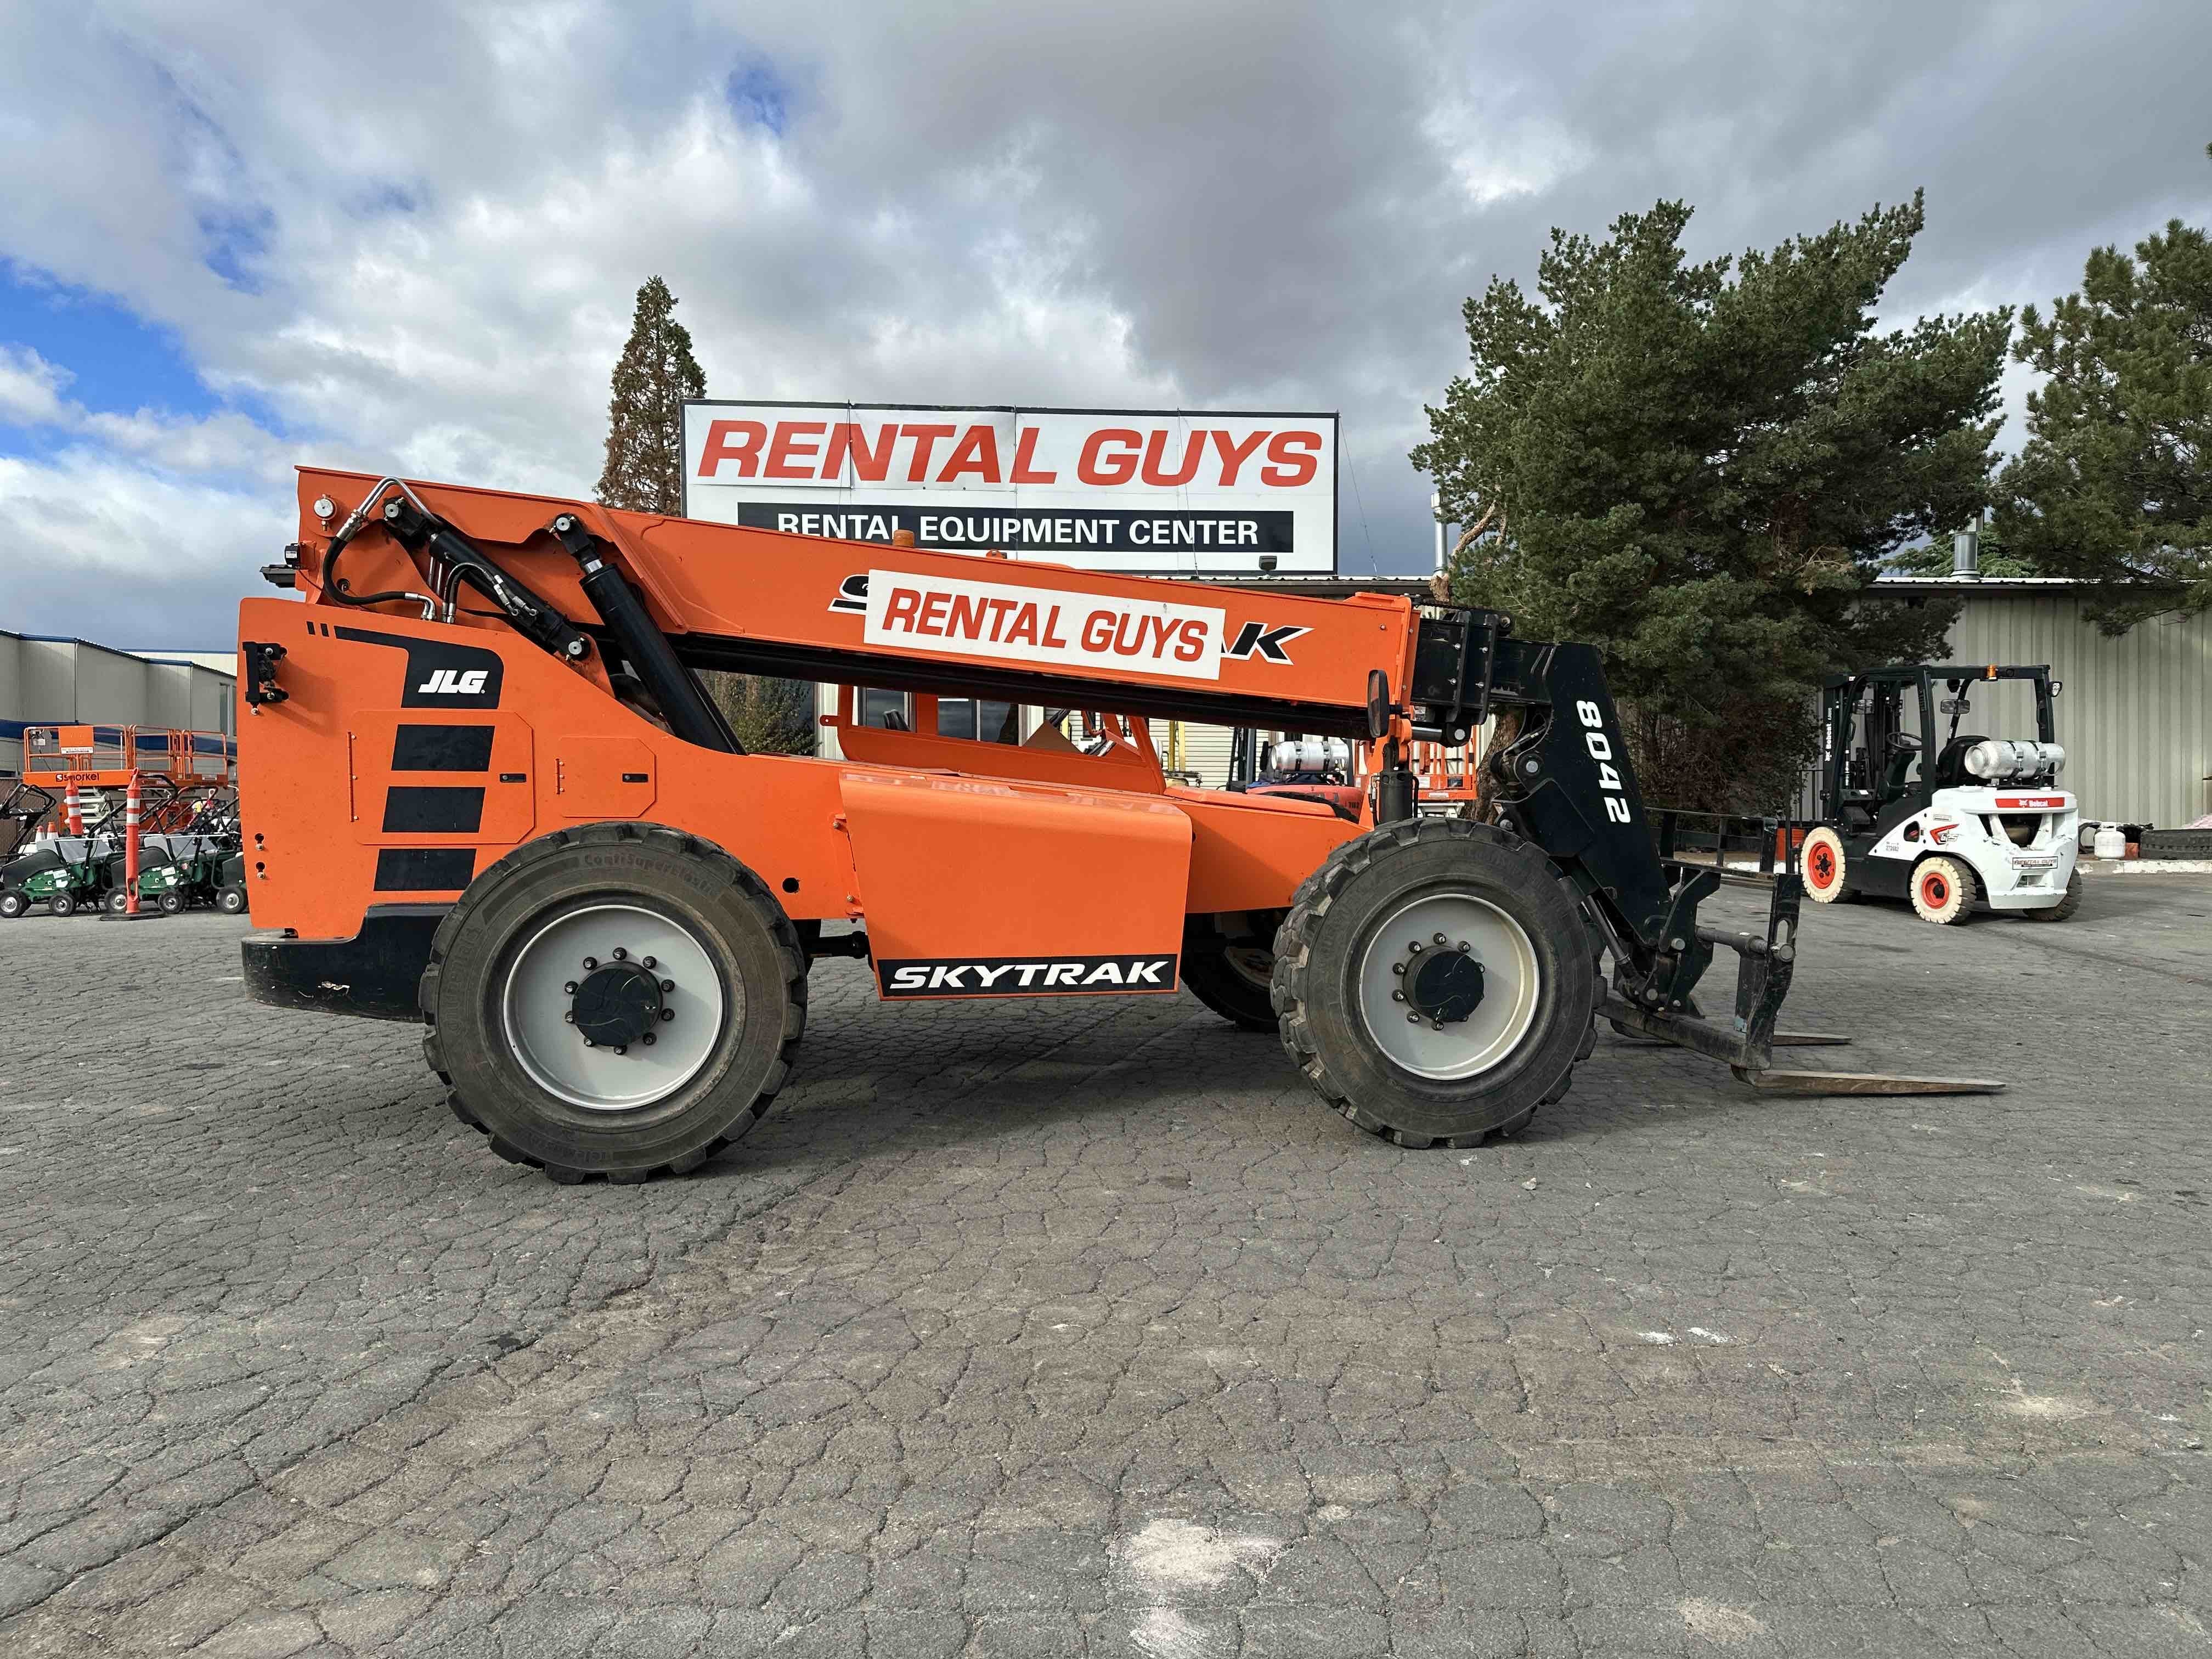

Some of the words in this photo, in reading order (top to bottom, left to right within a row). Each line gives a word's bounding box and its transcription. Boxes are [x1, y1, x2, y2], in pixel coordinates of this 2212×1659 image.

[698, 420, 1057, 484] RENTAL
[1077, 428, 1321, 487] GUYS
[920, 516, 1120, 545] EQUIPMENT
[1128, 520, 1258, 545] CENTER
[882, 588, 1066, 647] RENTAL
[1081, 610, 1208, 662] GUYS
[418, 670, 489, 694] JLG
[1576, 700, 1631, 823] 8042
[889, 961, 1169, 989] SKYTRAK
